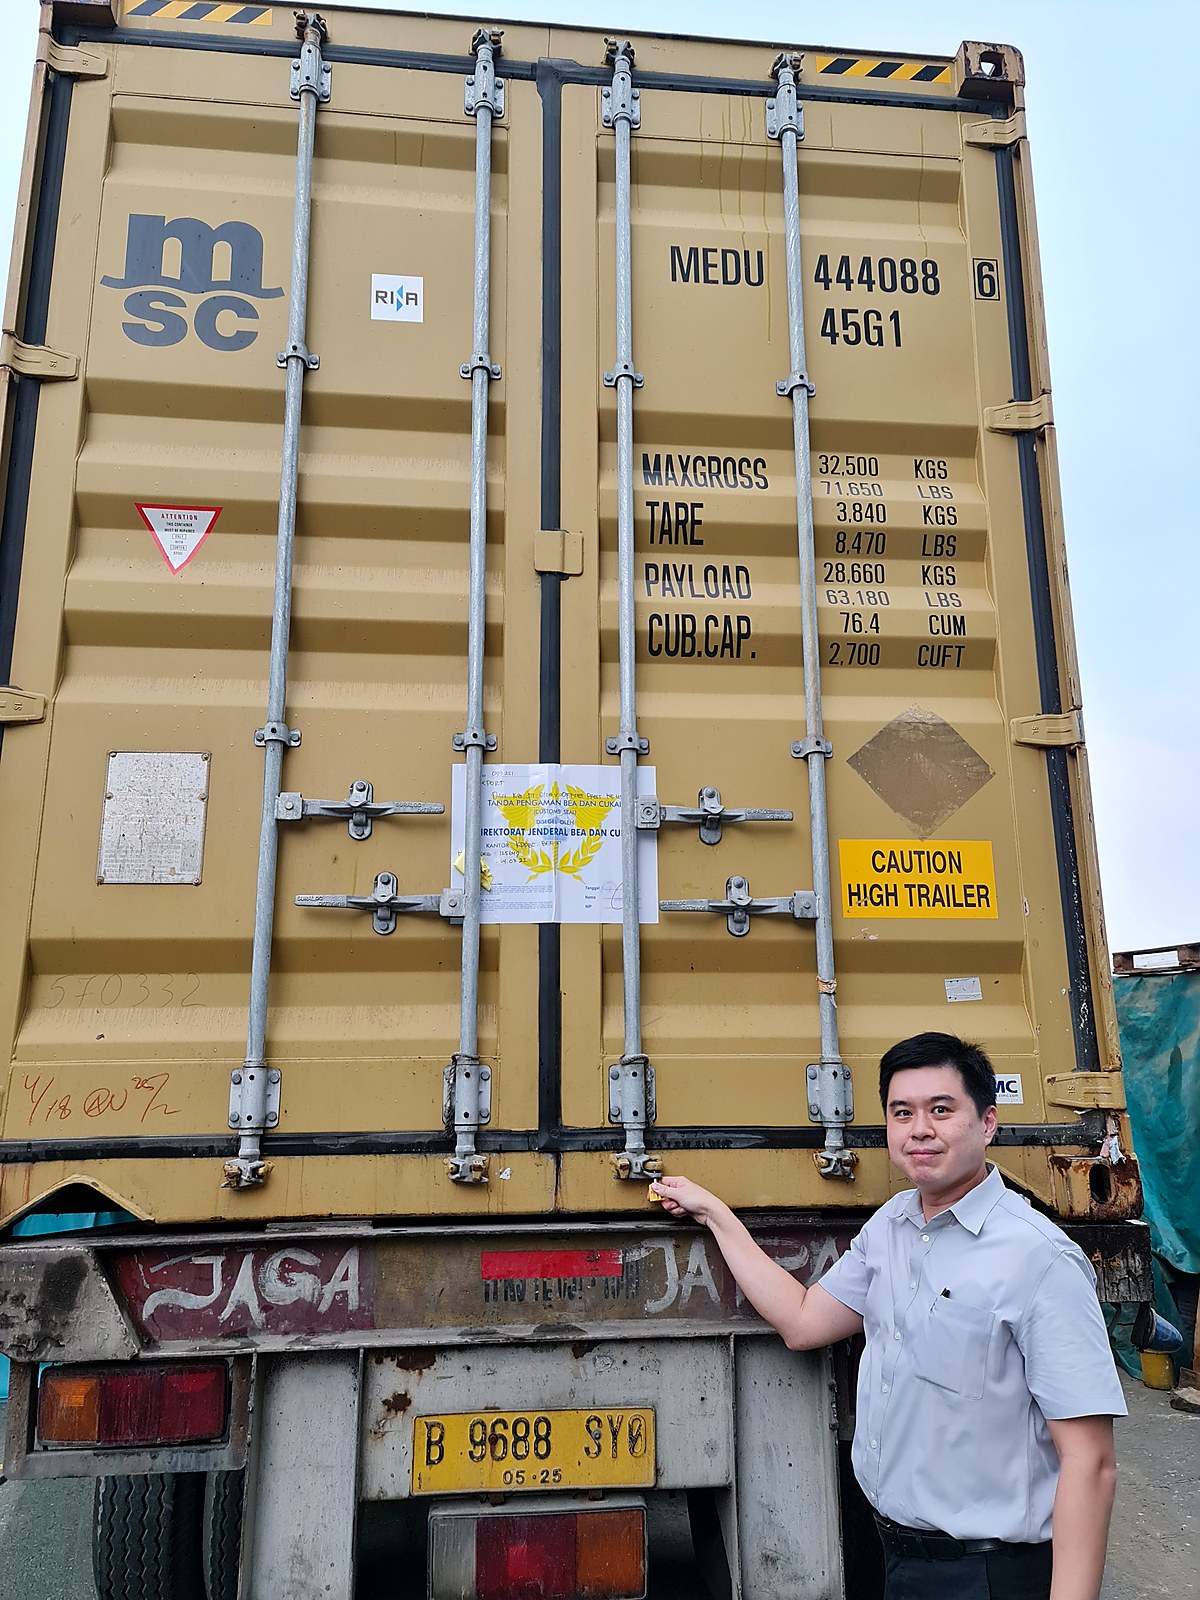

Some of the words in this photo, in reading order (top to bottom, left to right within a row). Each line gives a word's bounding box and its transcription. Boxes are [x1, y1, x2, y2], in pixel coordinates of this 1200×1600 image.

[670, 246, 764, 286] MEDU
[814, 254, 940, 295] 444088
[976, 261, 996, 297] 6
[820, 308, 902, 347] 45G1
[642, 453, 769, 489] MAXGROSS
[818, 454, 879, 476] 32,500
[914, 459, 948, 480] KGS
[917, 485, 953, 499] LBS
[645, 501, 704, 545] TARE
[836, 502, 887, 523] 3,840
[923, 504, 957, 526] KGS
[835, 531, 886, 555] 8,470
[921, 533, 957, 557] LBS
[645, 563, 752, 599] PAYLOAD
[823, 562, 885, 584] 28,660
[921, 564, 956, 586] KGS
[925, 591, 962, 608] LBS
[648, 613, 756, 659] CUB.CAP.
[840, 612, 880, 634] 76.4
[929, 614, 966, 636] CUM
[828, 642, 880, 666] 2,700
[917, 645, 965, 667] CUFT
[480, 828, 525, 836] IREKTORAT
[528, 828, 568, 837] JENDERAL
[571, 828, 586, 837] BEA
[589, 829, 607, 837] DAN
[609, 829, 621, 837] CU
[872, 850, 962, 874] CAUTION
[848, 883, 899, 907] HIGH
[904, 883, 990, 908] TRAILER
[43, 973, 207, 1010] 570332
[996, 1080, 1018, 1093] MC
[142, 1246, 359, 1328] JAGA
[424, 1421, 445, 1466] B
[468, 1416, 551, 1462] 9688
